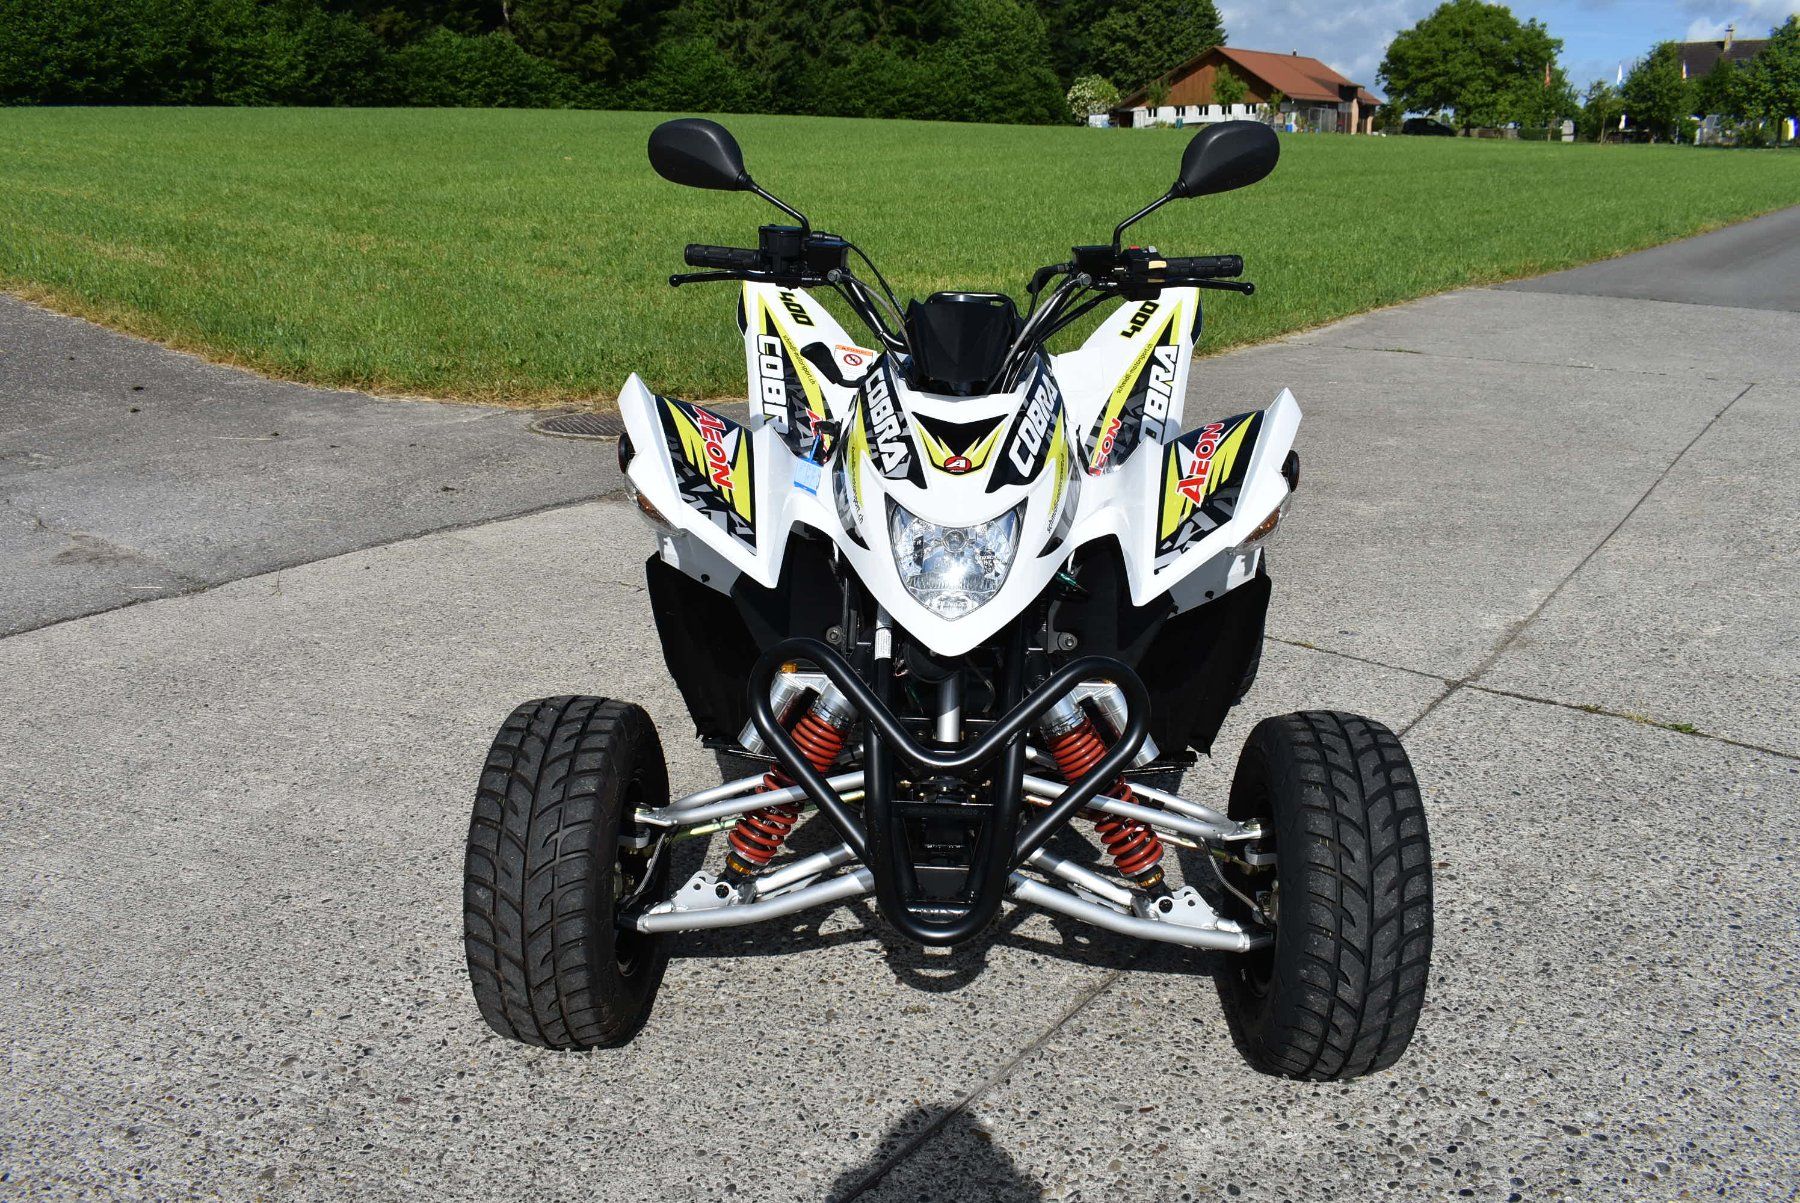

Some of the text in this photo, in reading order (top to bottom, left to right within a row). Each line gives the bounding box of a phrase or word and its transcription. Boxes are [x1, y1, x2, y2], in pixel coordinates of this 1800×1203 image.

[780, 291, 815, 326] 400
[1120, 300, 1160, 338] 400
[757, 333, 789, 434] COBR
[866, 367, 909, 474] COBRA
[1008, 375, 1059, 478] COBRA
[1139, 344, 1180, 445] OBRA
[691, 405, 735, 491] AEON
[1177, 422, 1225, 507] AEON
